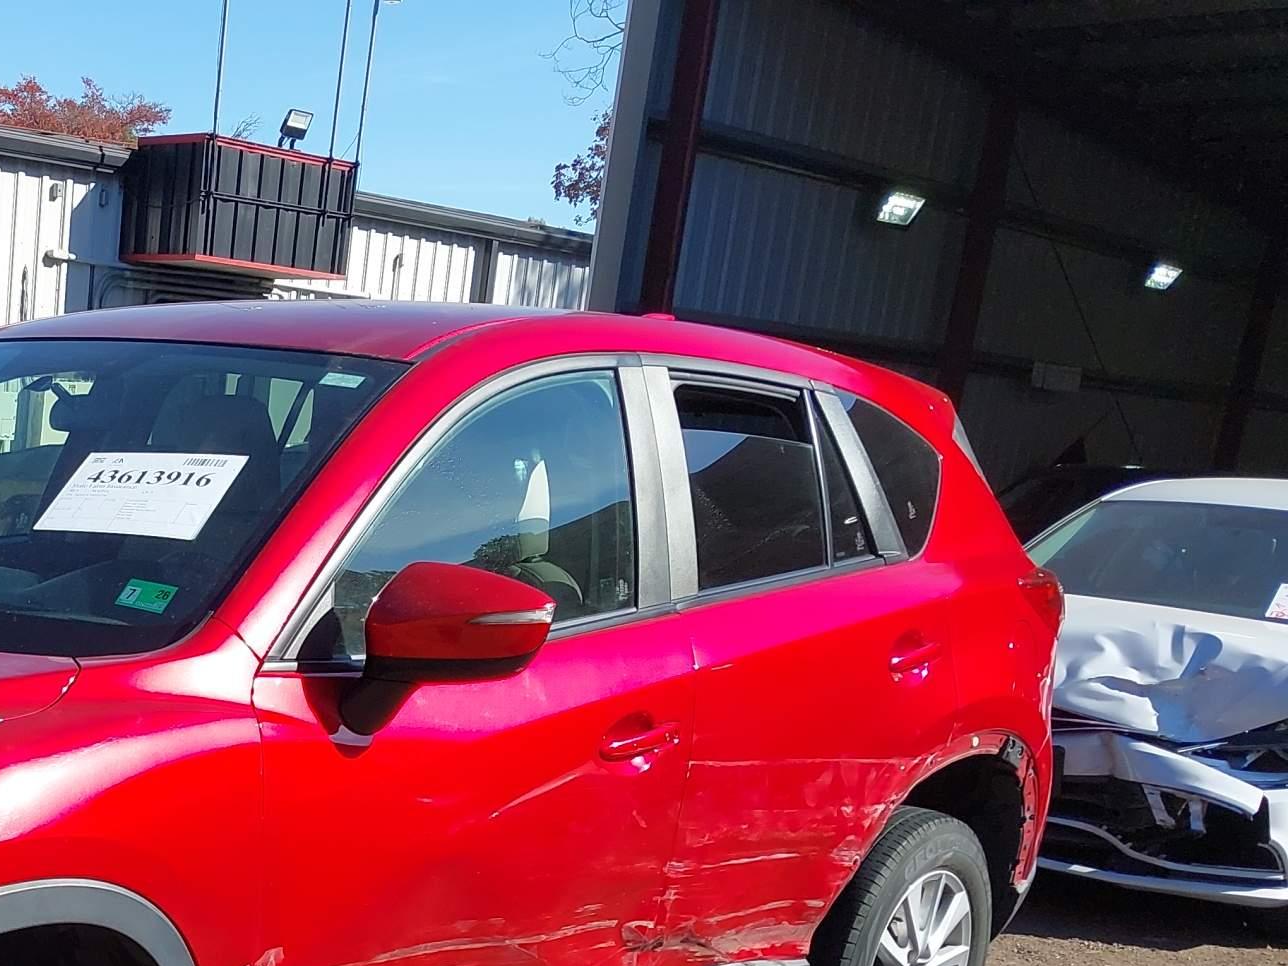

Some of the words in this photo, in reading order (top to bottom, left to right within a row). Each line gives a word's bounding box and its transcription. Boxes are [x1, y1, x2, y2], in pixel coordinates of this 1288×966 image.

[87, 468, 216, 488] 43613916
[126, 588, 137, 600] 7
[155, 589, 171, 600] 26
